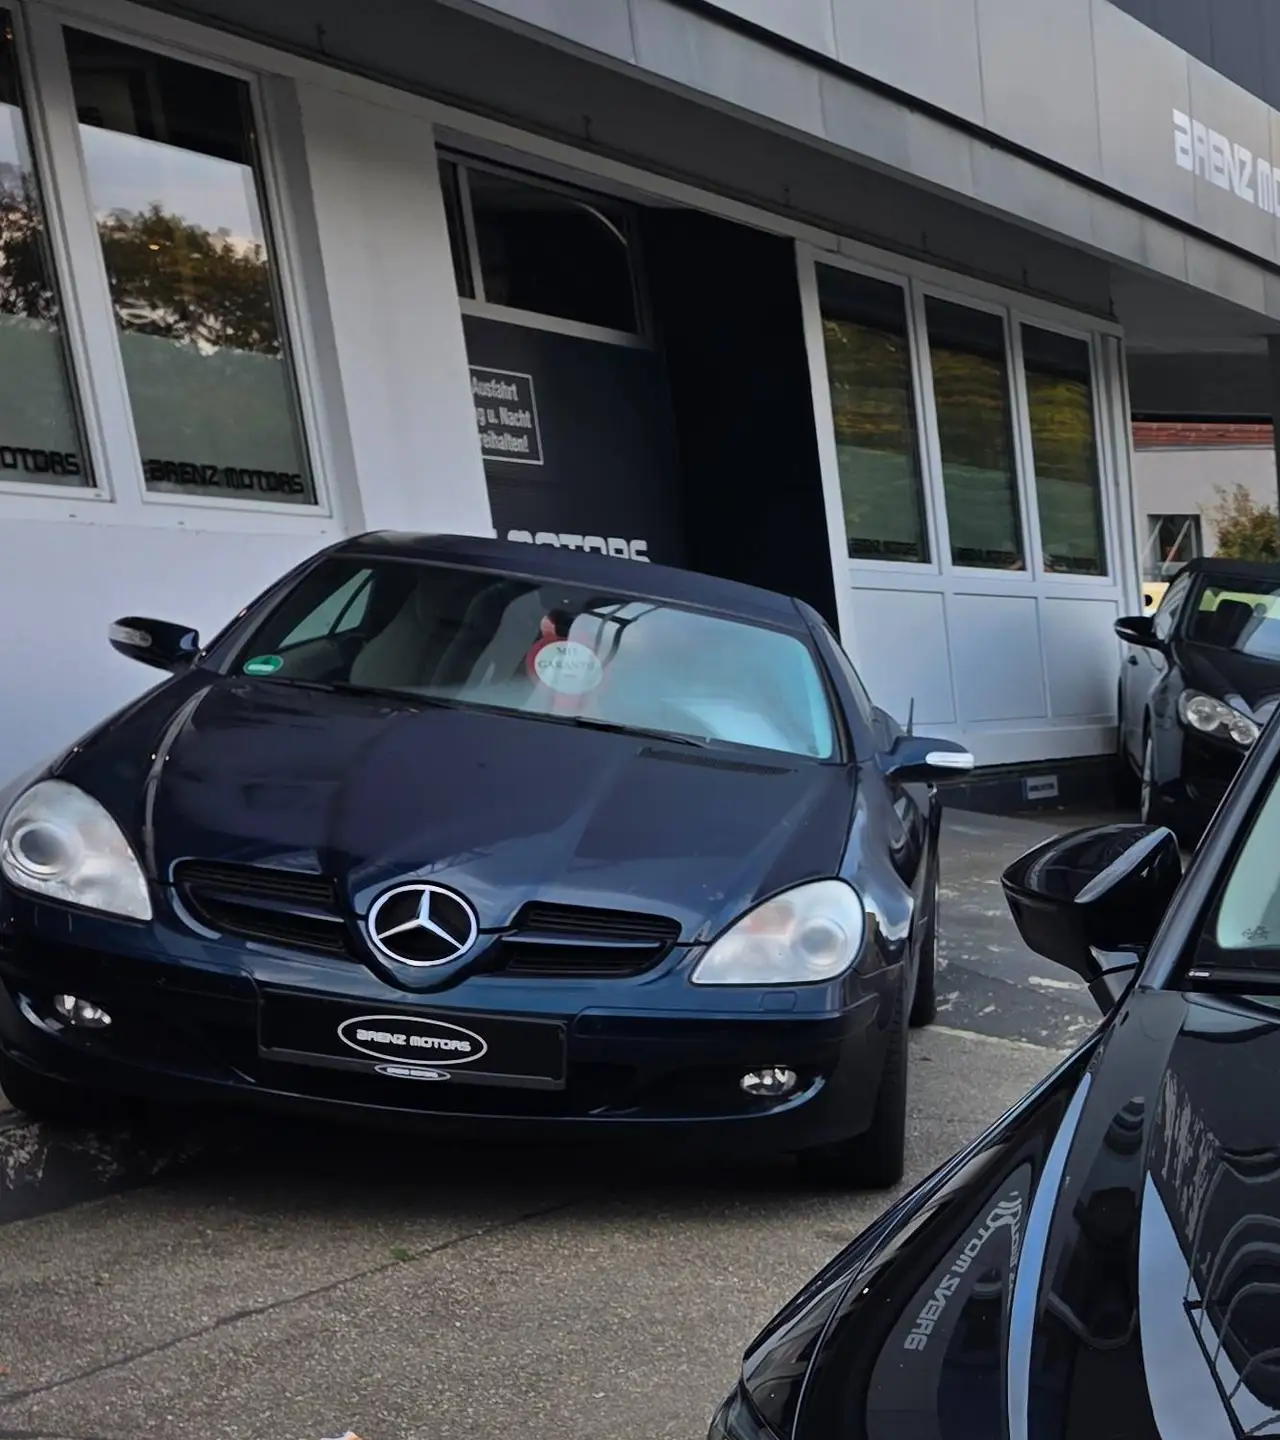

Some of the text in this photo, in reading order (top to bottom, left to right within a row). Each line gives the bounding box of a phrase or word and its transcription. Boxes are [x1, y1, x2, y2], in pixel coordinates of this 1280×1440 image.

[1172, 108, 1255, 204] BRENZ
[472, 376, 518, 401] Ausfahrt
[499, 406, 532, 428] Nacht
[0, 446, 81, 475] OTORS
[146, 459, 304, 494] BRENZ MOTORS
[356, 1029, 471, 1052] BRENZ MOTORS
